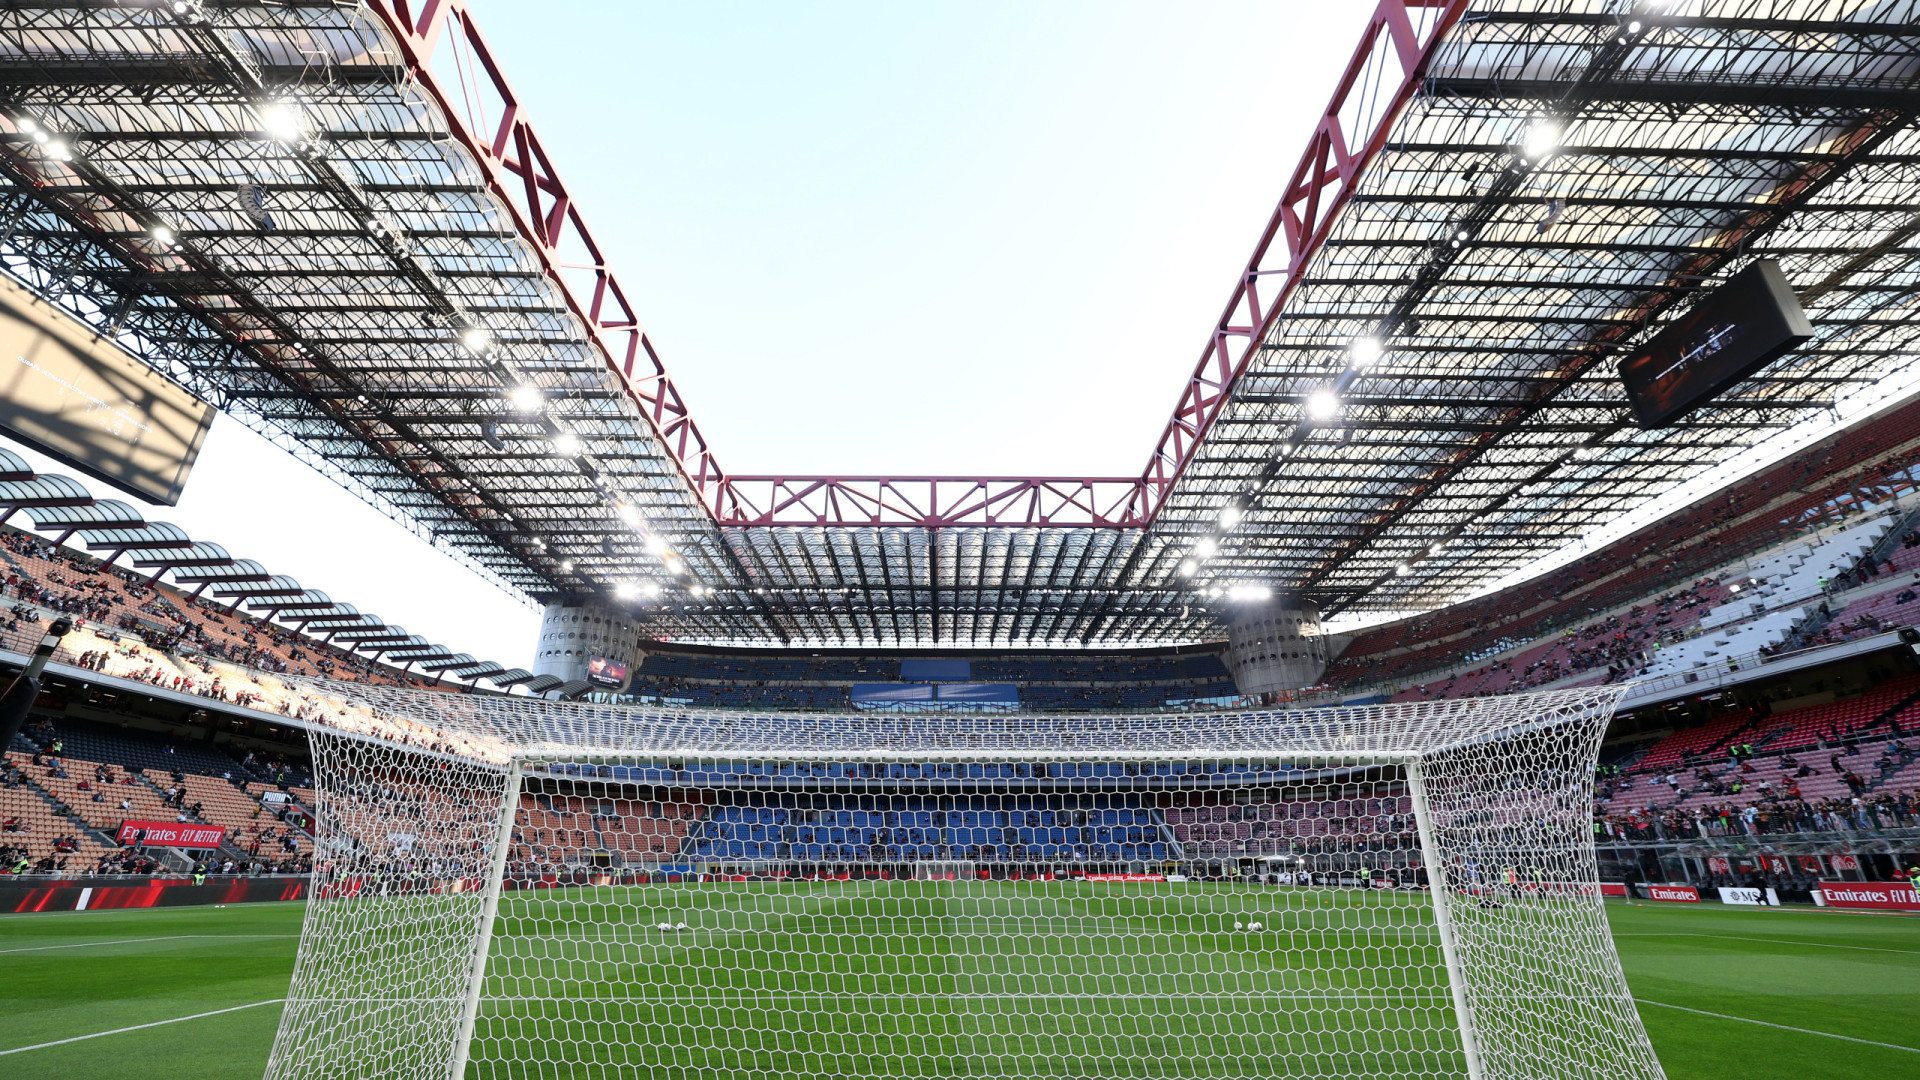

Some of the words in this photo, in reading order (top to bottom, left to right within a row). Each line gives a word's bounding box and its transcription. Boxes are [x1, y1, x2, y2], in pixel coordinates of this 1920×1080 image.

[262, 791, 287, 803] PUMA
[179, 829, 195, 842] FLY
[193, 830, 222, 843] BETTER
[1651, 888, 1697, 901] Emirates
[1742, 891, 1761, 902] MS
[1823, 888, 1888, 903] Emirates
[1889, 889, 1907, 903] FLY
